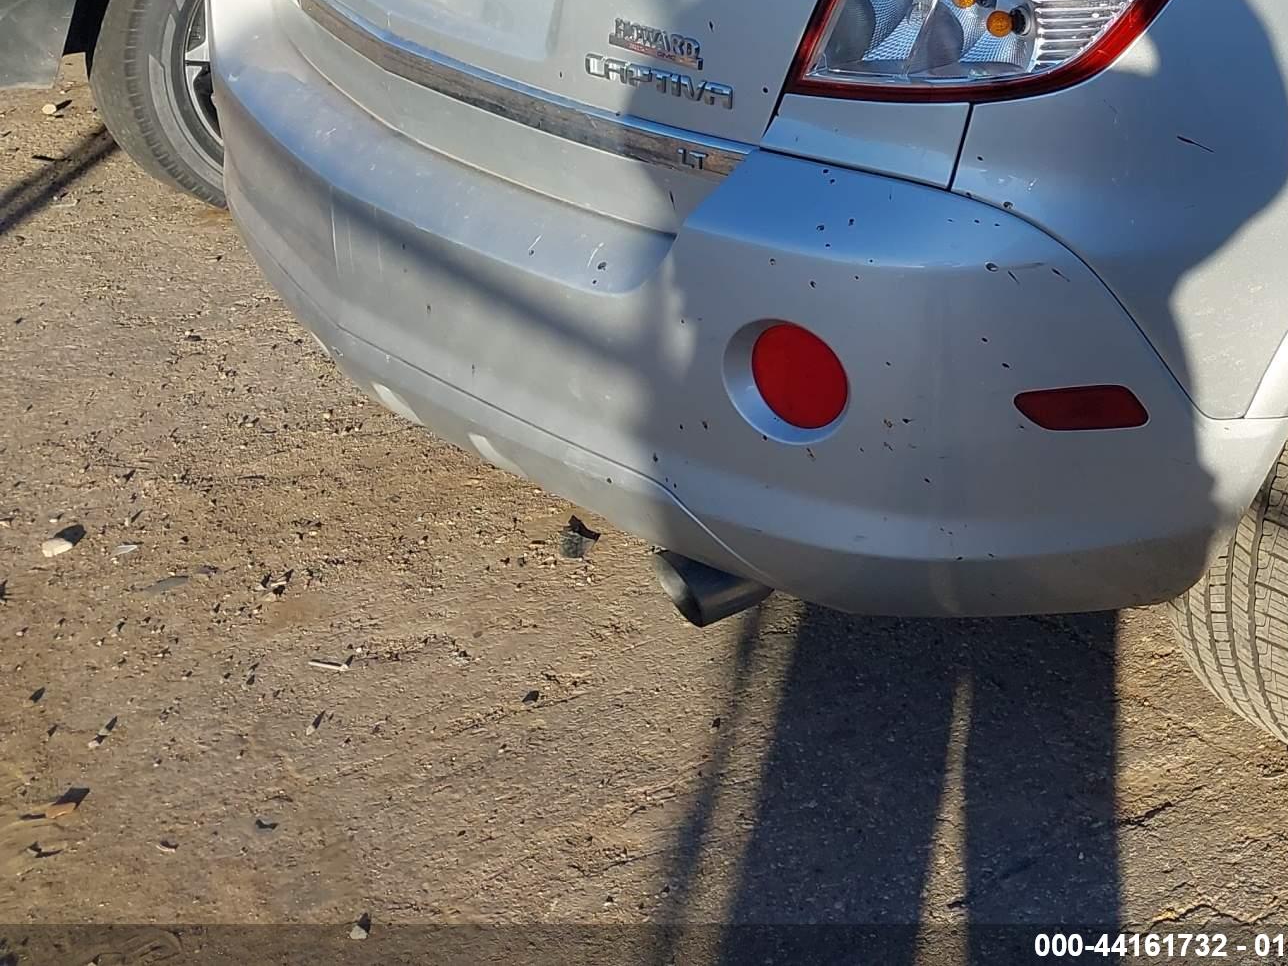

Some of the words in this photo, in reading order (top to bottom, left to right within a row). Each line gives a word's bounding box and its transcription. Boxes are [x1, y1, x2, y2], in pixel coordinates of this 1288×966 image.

[613, 17, 701, 60] HOWARD
[585, 52, 733, 109] CAPTIVA
[677, 147, 709, 170] LT
